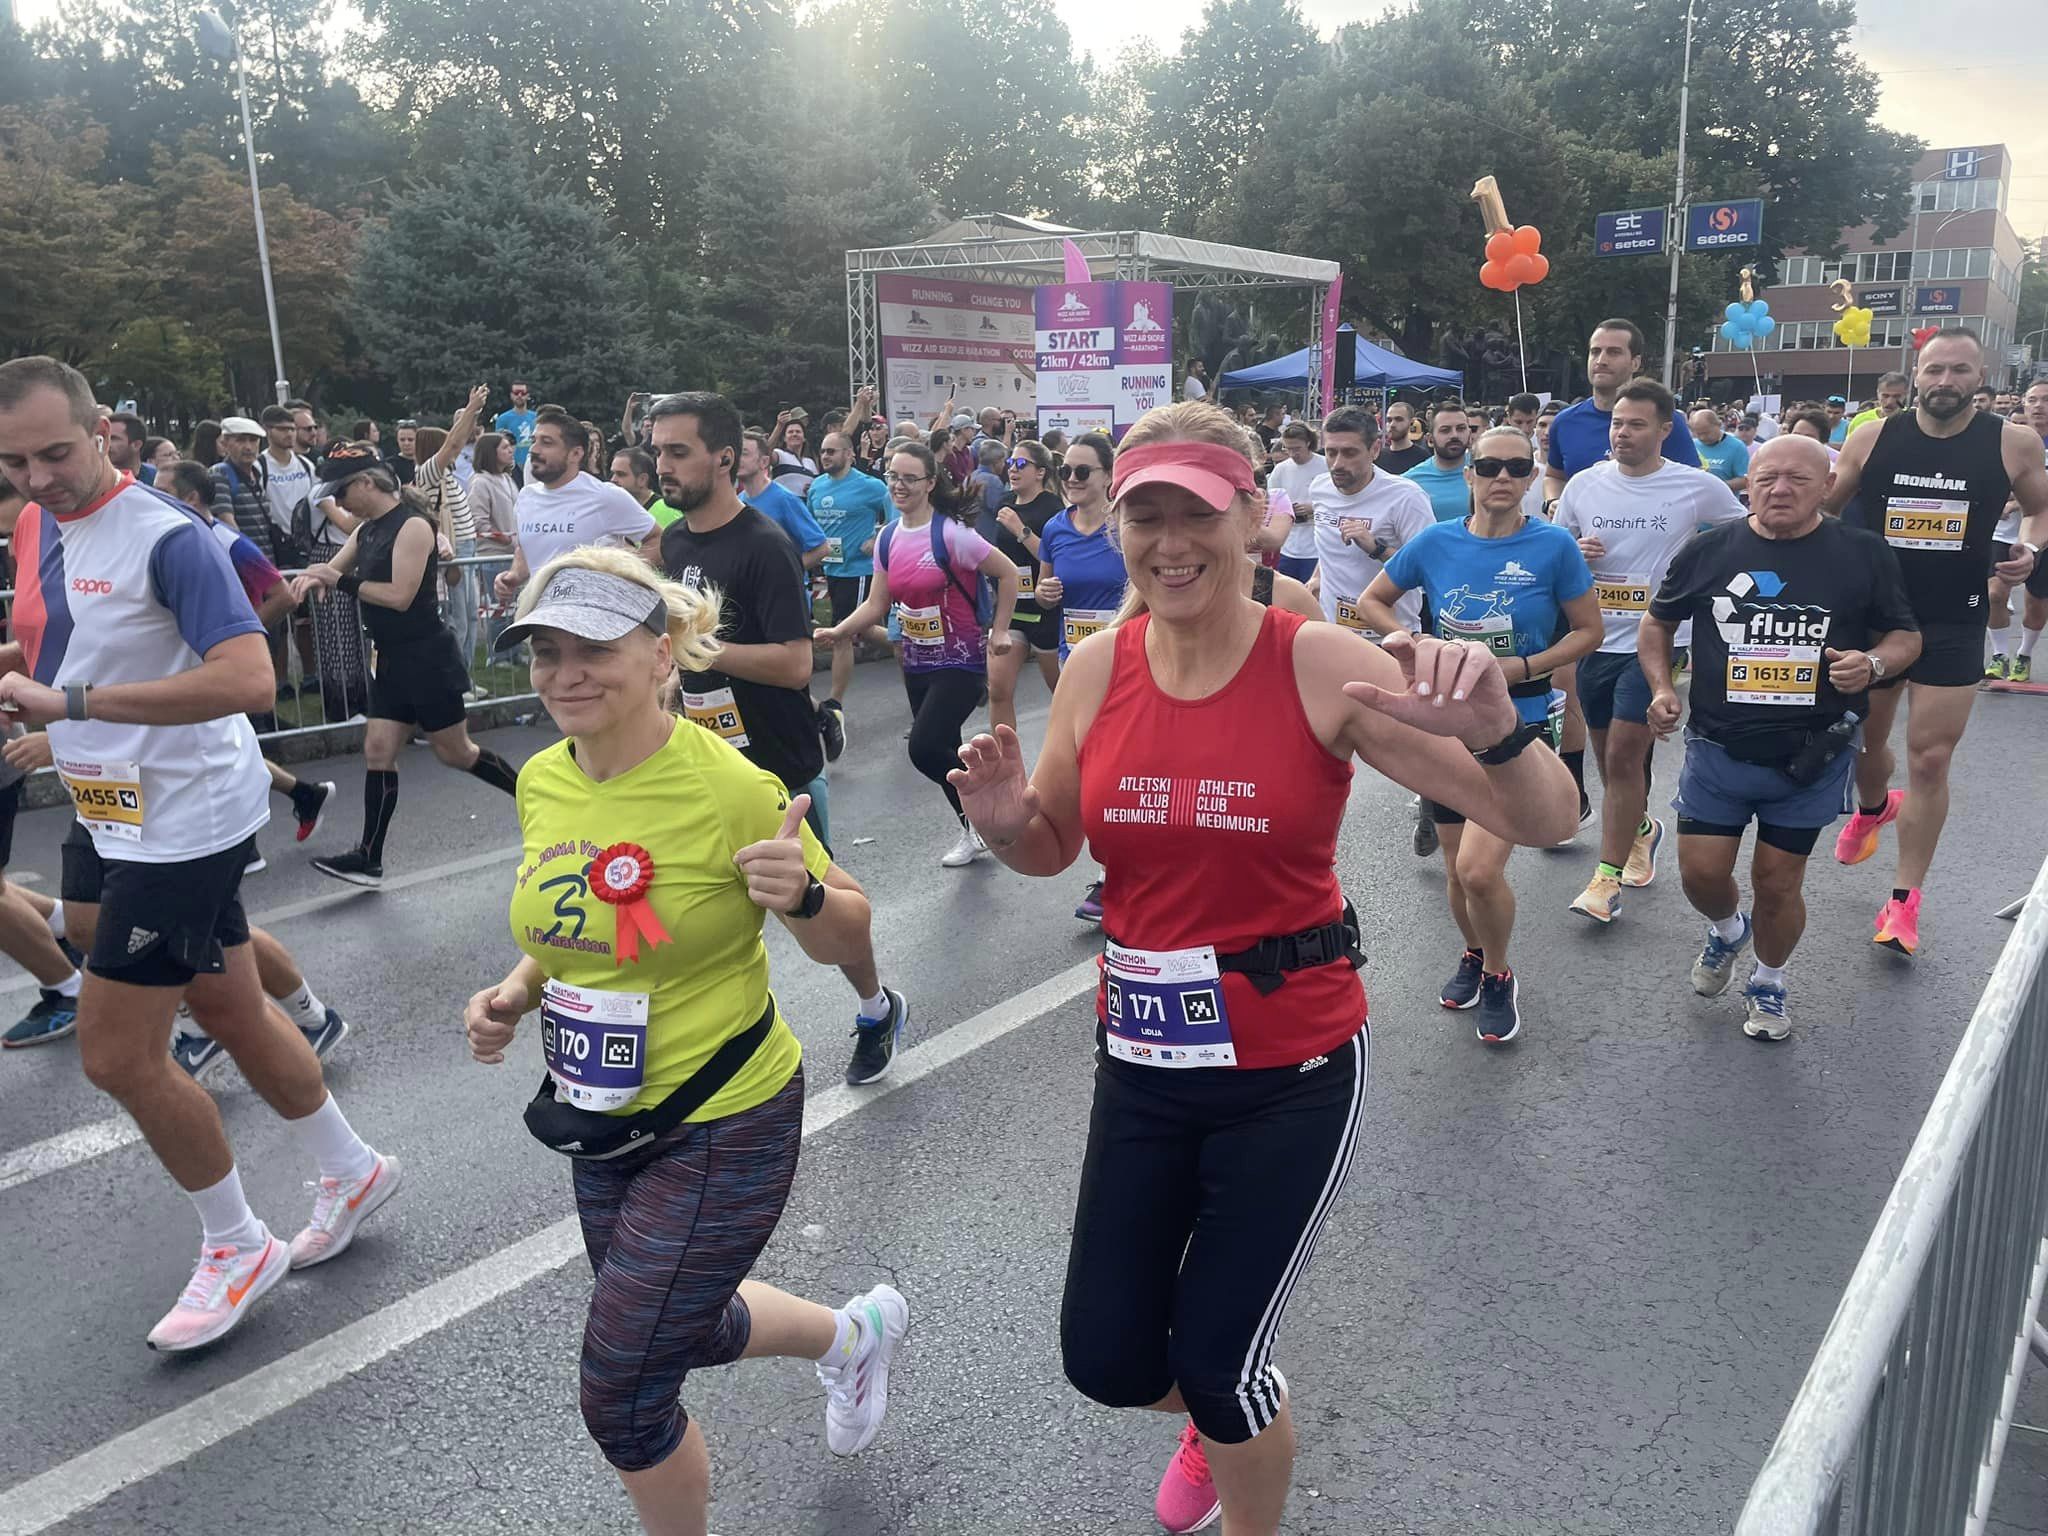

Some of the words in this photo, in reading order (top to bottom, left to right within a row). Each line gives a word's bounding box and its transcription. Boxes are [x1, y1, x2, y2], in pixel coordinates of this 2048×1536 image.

[1615, 213, 1642, 230] st
[1615, 238, 1656, 250] setec
[1696, 232, 1749, 245] setec
[912, 289, 953, 302] RUNNING
[970, 294, 1003, 306] CHANGE
[1004, 298, 1022, 309] YOU
[1865, 292, 1895, 300] SONY
[1921, 304, 1953, 312] setec
[1048, 330, 1100, 349] START
[1138, 334, 1147, 342] AIR
[901, 343, 923, 353] WIZZ
[923, 344, 938, 353] AIR
[1041, 354, 1068, 368] 21km
[1070, 353, 1077, 369] /
[1078, 353, 1110, 367] 42km
[1121, 375, 1166, 390] RUNNING
[1135, 397, 1154, 410] YOU
[1893, 472, 1967, 490] IRONMAN
[521, 523, 575, 533] INSCALE
[1592, 516, 1646, 530] Qinshift
[1906, 519, 1943, 531] 2714
[72, 578, 112, 596] sopro
[1601, 590, 1630, 600] 2410
[1077, 626, 1097, 636] 1191
[1750, 613, 1831, 639] fluid
[1753, 667, 1790, 681] 1613
[1118, 776, 1171, 793] ATLETSKI
[1198, 779, 1256, 798] ATHLETIC
[72, 786, 118, 806] 2455
[1139, 793, 1170, 809] KLUB
[1196, 796, 1228, 813] CLUB
[1103, 808, 1168, 825] MEĐIMURJE
[1196, 812, 1270, 833] MEĐIMURJE
[549, 935, 611, 954] maraton
[1111, 951, 1146, 965] MARATHON
[551, 984, 581, 1001] MARATHON
[1128, 993, 1166, 1022] 171
[560, 1028, 590, 1060] 170
[1299, 1057, 1329, 1073] adidas
